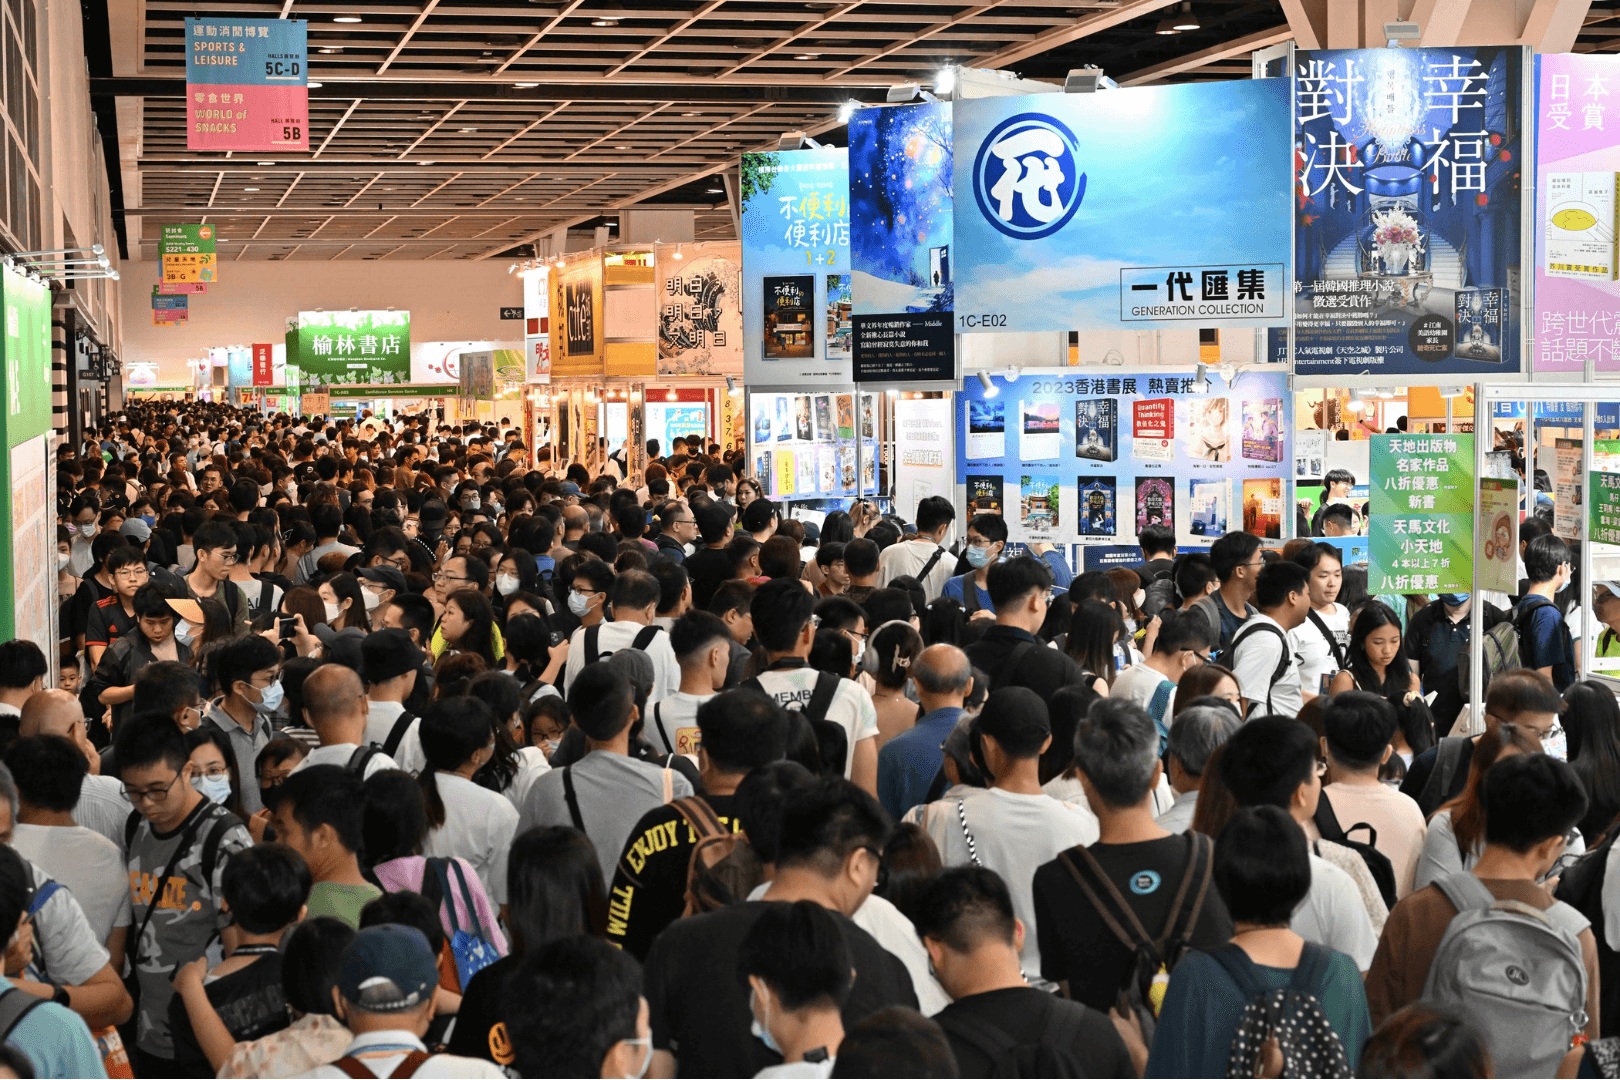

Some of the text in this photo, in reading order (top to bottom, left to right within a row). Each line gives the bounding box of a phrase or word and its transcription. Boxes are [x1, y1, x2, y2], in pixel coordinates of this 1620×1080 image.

[194, 42, 246, 52] SPORTS &
[194, 56, 238, 66] LEISURE
[266, 62, 300, 76] 5C-D
[194, 93, 244, 104] 零食世界
[195, 109, 248, 120] WORLD of
[195, 122, 237, 134] SNACKS
[1296, 58, 1366, 197] 對決
[1422, 55, 1490, 195] 幸福
[284, 126, 302, 140] 5B
[1131, 269, 1266, 302] 一代匯集
[1131, 304, 1264, 316] GENERATION COLLECTION
[959, 314, 1007, 328] 1C-E02
[312, 334, 401, 356] 榆林書店
[1032, 377, 1136, 396] 2023香港書展
[1388, 438, 1458, 454] 天地出版物
[1396, 458, 1449, 472] 名家作品
[1384, 476, 1439, 491] 八折優惠
[1408, 494, 1436, 509] 新書
[1393, 518, 1451, 534] 天馬文化
[1400, 538, 1444, 554] 小天地
[1380, 574, 1439, 590] 八折優惠
[626, 820, 678, 874] ENJOY
[607, 885, 634, 936] WILL
